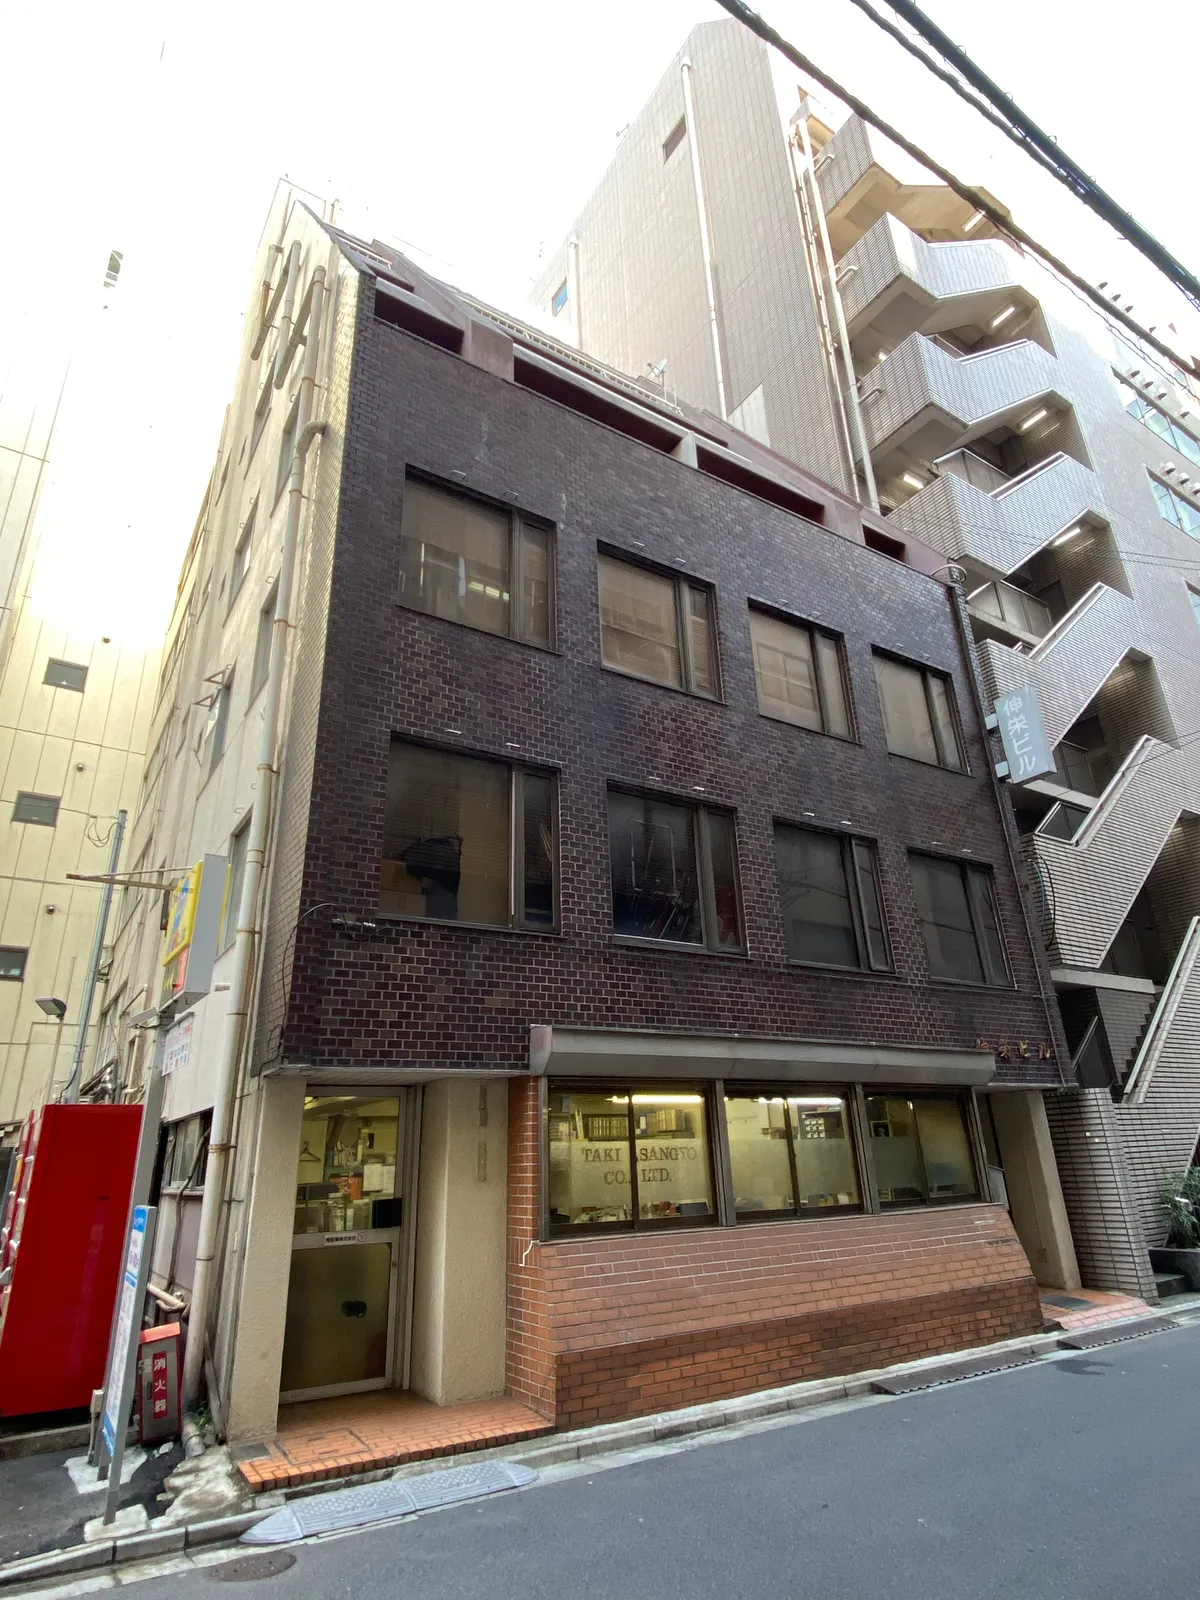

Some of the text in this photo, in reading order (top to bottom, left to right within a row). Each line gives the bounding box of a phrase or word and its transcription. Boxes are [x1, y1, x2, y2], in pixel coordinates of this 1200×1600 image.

[1003, 696, 1036, 775] 伸栄ビル
[582, 1146, 697, 1162] TAKI SANGYO
[641, 1168, 672, 1182] LTD.
[153, 1357, 167, 1413] 消火器
